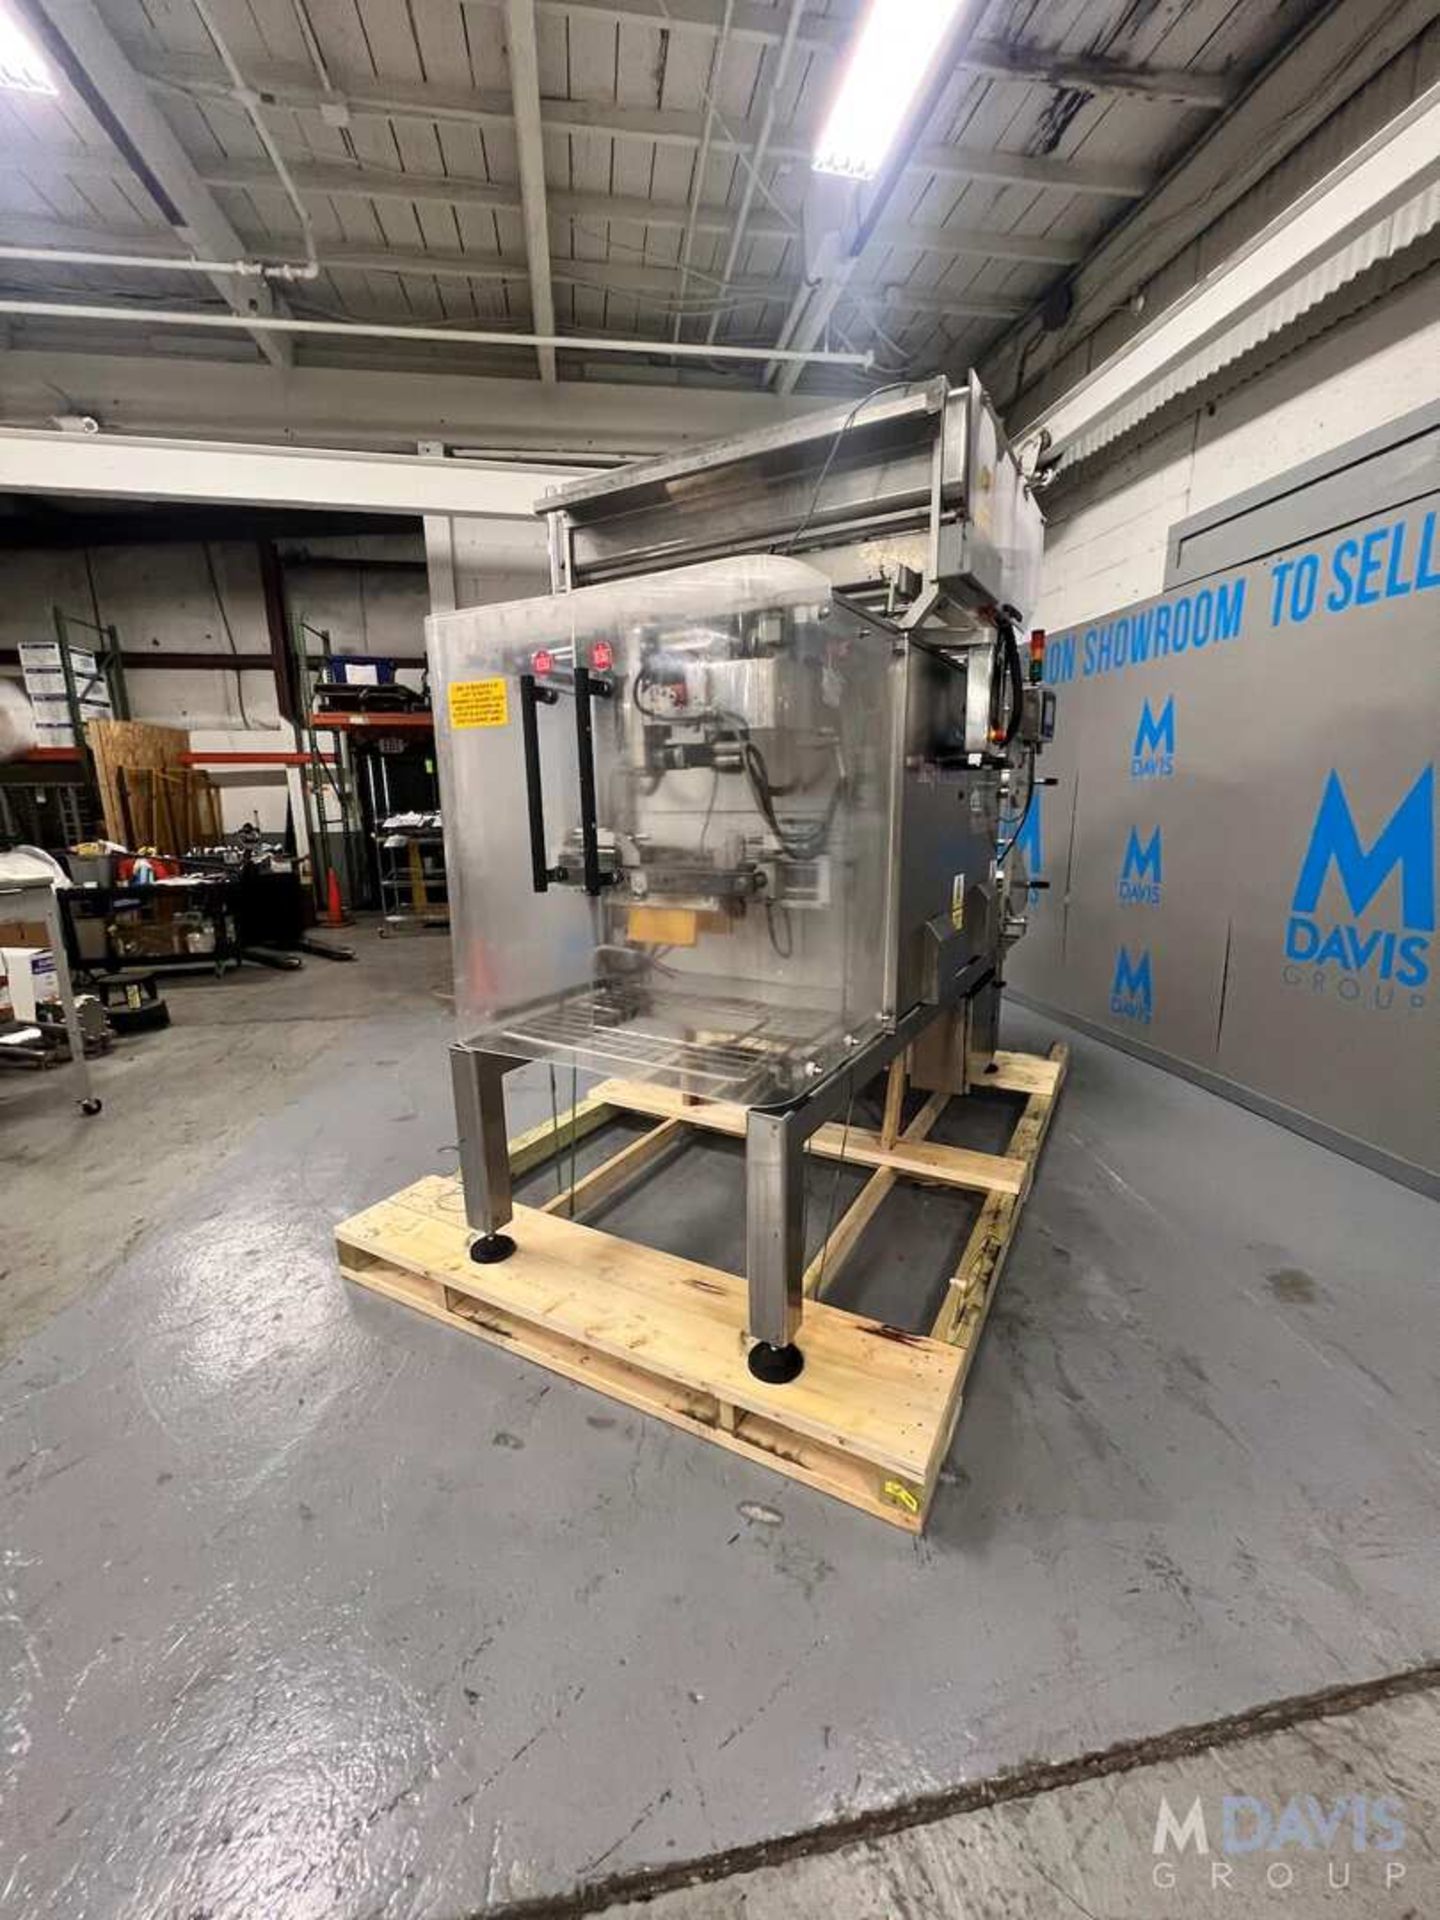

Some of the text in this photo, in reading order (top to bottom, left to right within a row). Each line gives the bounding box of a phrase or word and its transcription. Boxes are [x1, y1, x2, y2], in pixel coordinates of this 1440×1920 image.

[1084, 577, 1245, 676] SHOWROOM
[1272, 554, 1320, 627] TO
[1327, 511, 1440, 612] SELL
[1134, 694, 1174, 756] M
[1131, 754, 1173, 777] DAVIS
[1122, 823, 1161, 882] M
[1294, 762, 1435, 931] M
[1119, 881, 1160, 904] DAVIS
[1113, 944, 1151, 1006] M
[1286, 917, 1430, 987] DAVIS
